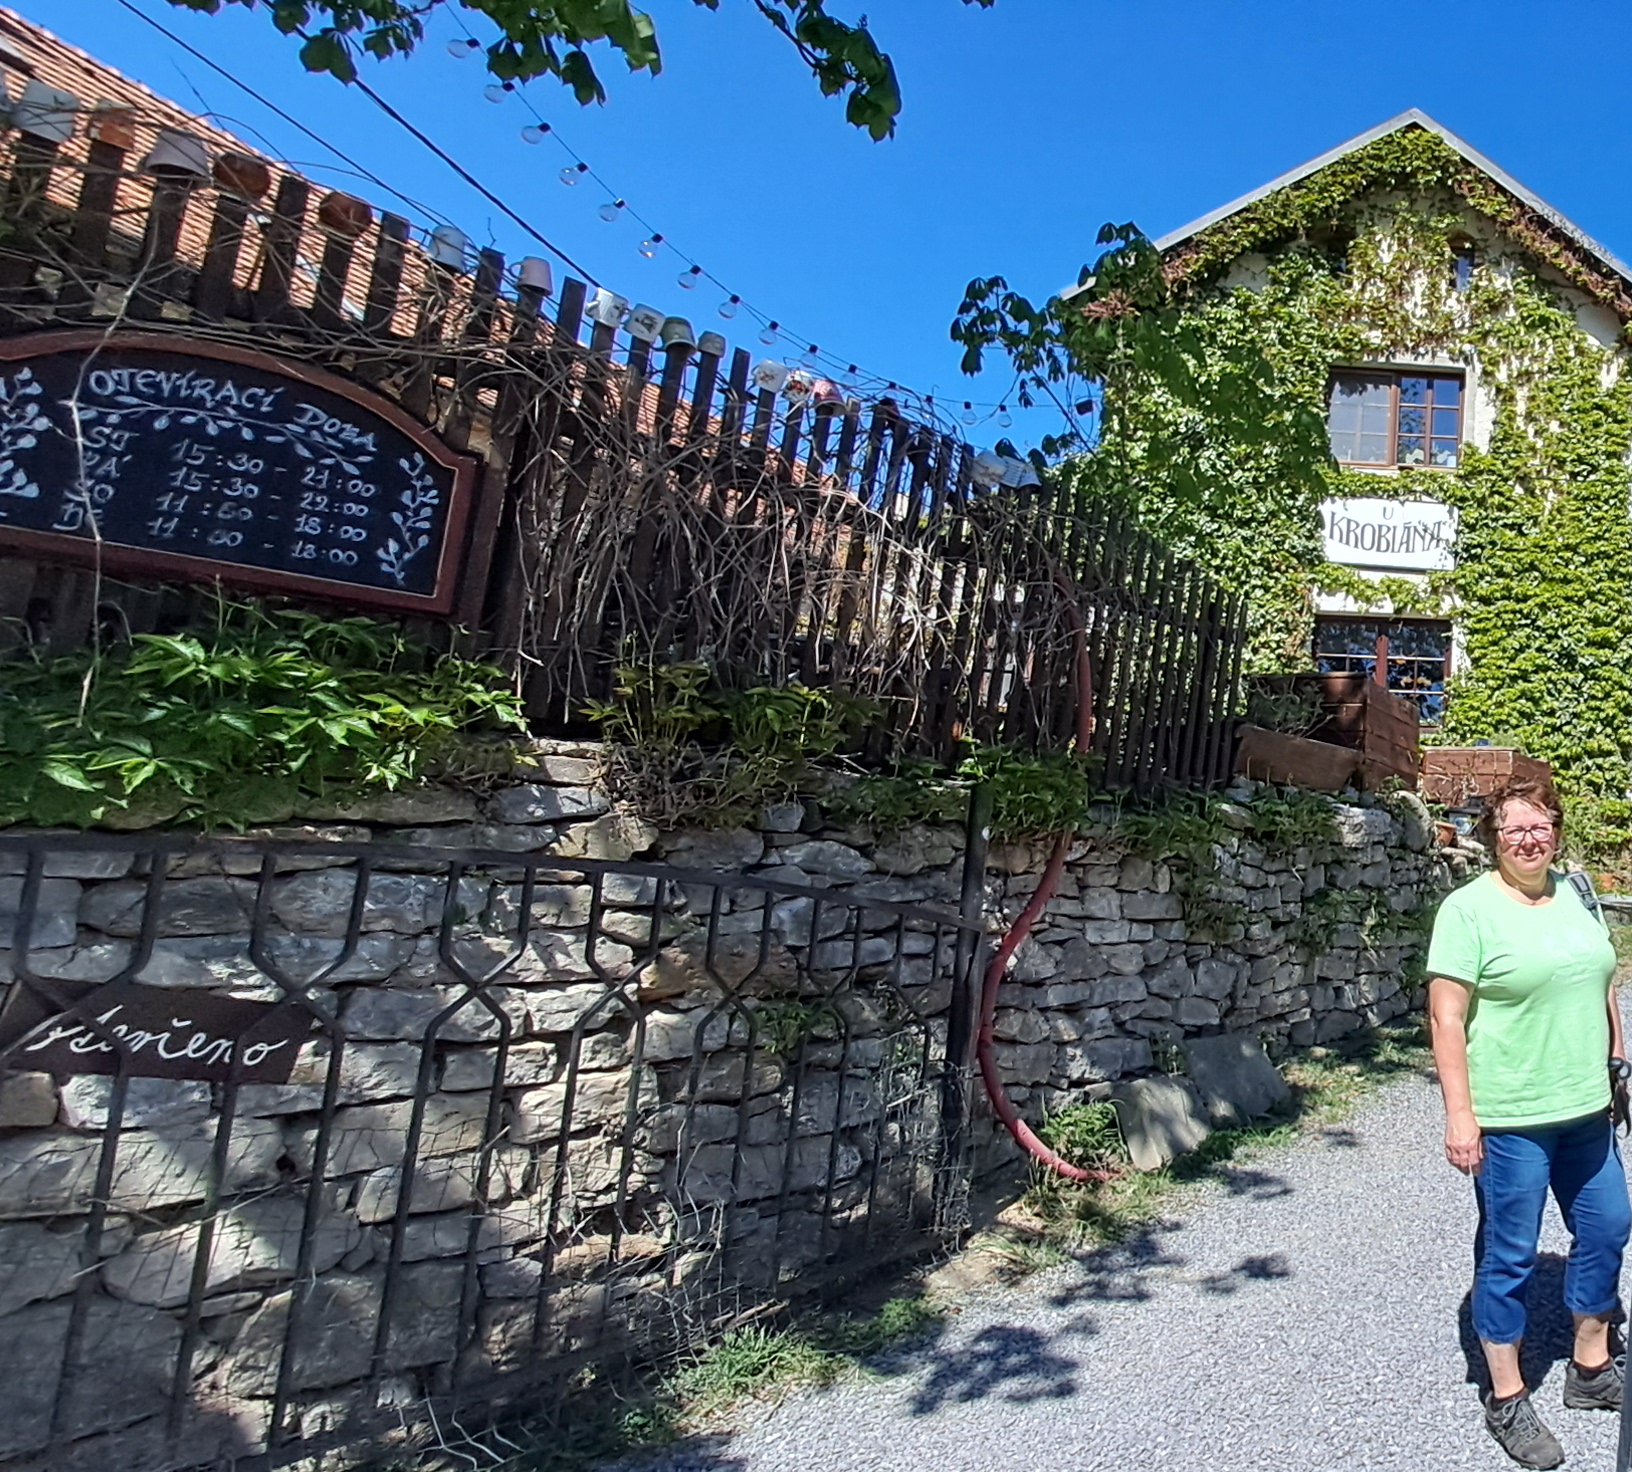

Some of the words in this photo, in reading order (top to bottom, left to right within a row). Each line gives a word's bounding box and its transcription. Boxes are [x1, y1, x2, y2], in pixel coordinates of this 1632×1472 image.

[171, 438, 264, 474] 15:30
[301, 466, 376, 498] 21:00
[168, 467, 259, 499] 15:30
[300, 492, 369, 517] 22:00
[1382, 506, 1394, 521] U
[1328, 510, 1443, 553] KROBIÁNA
